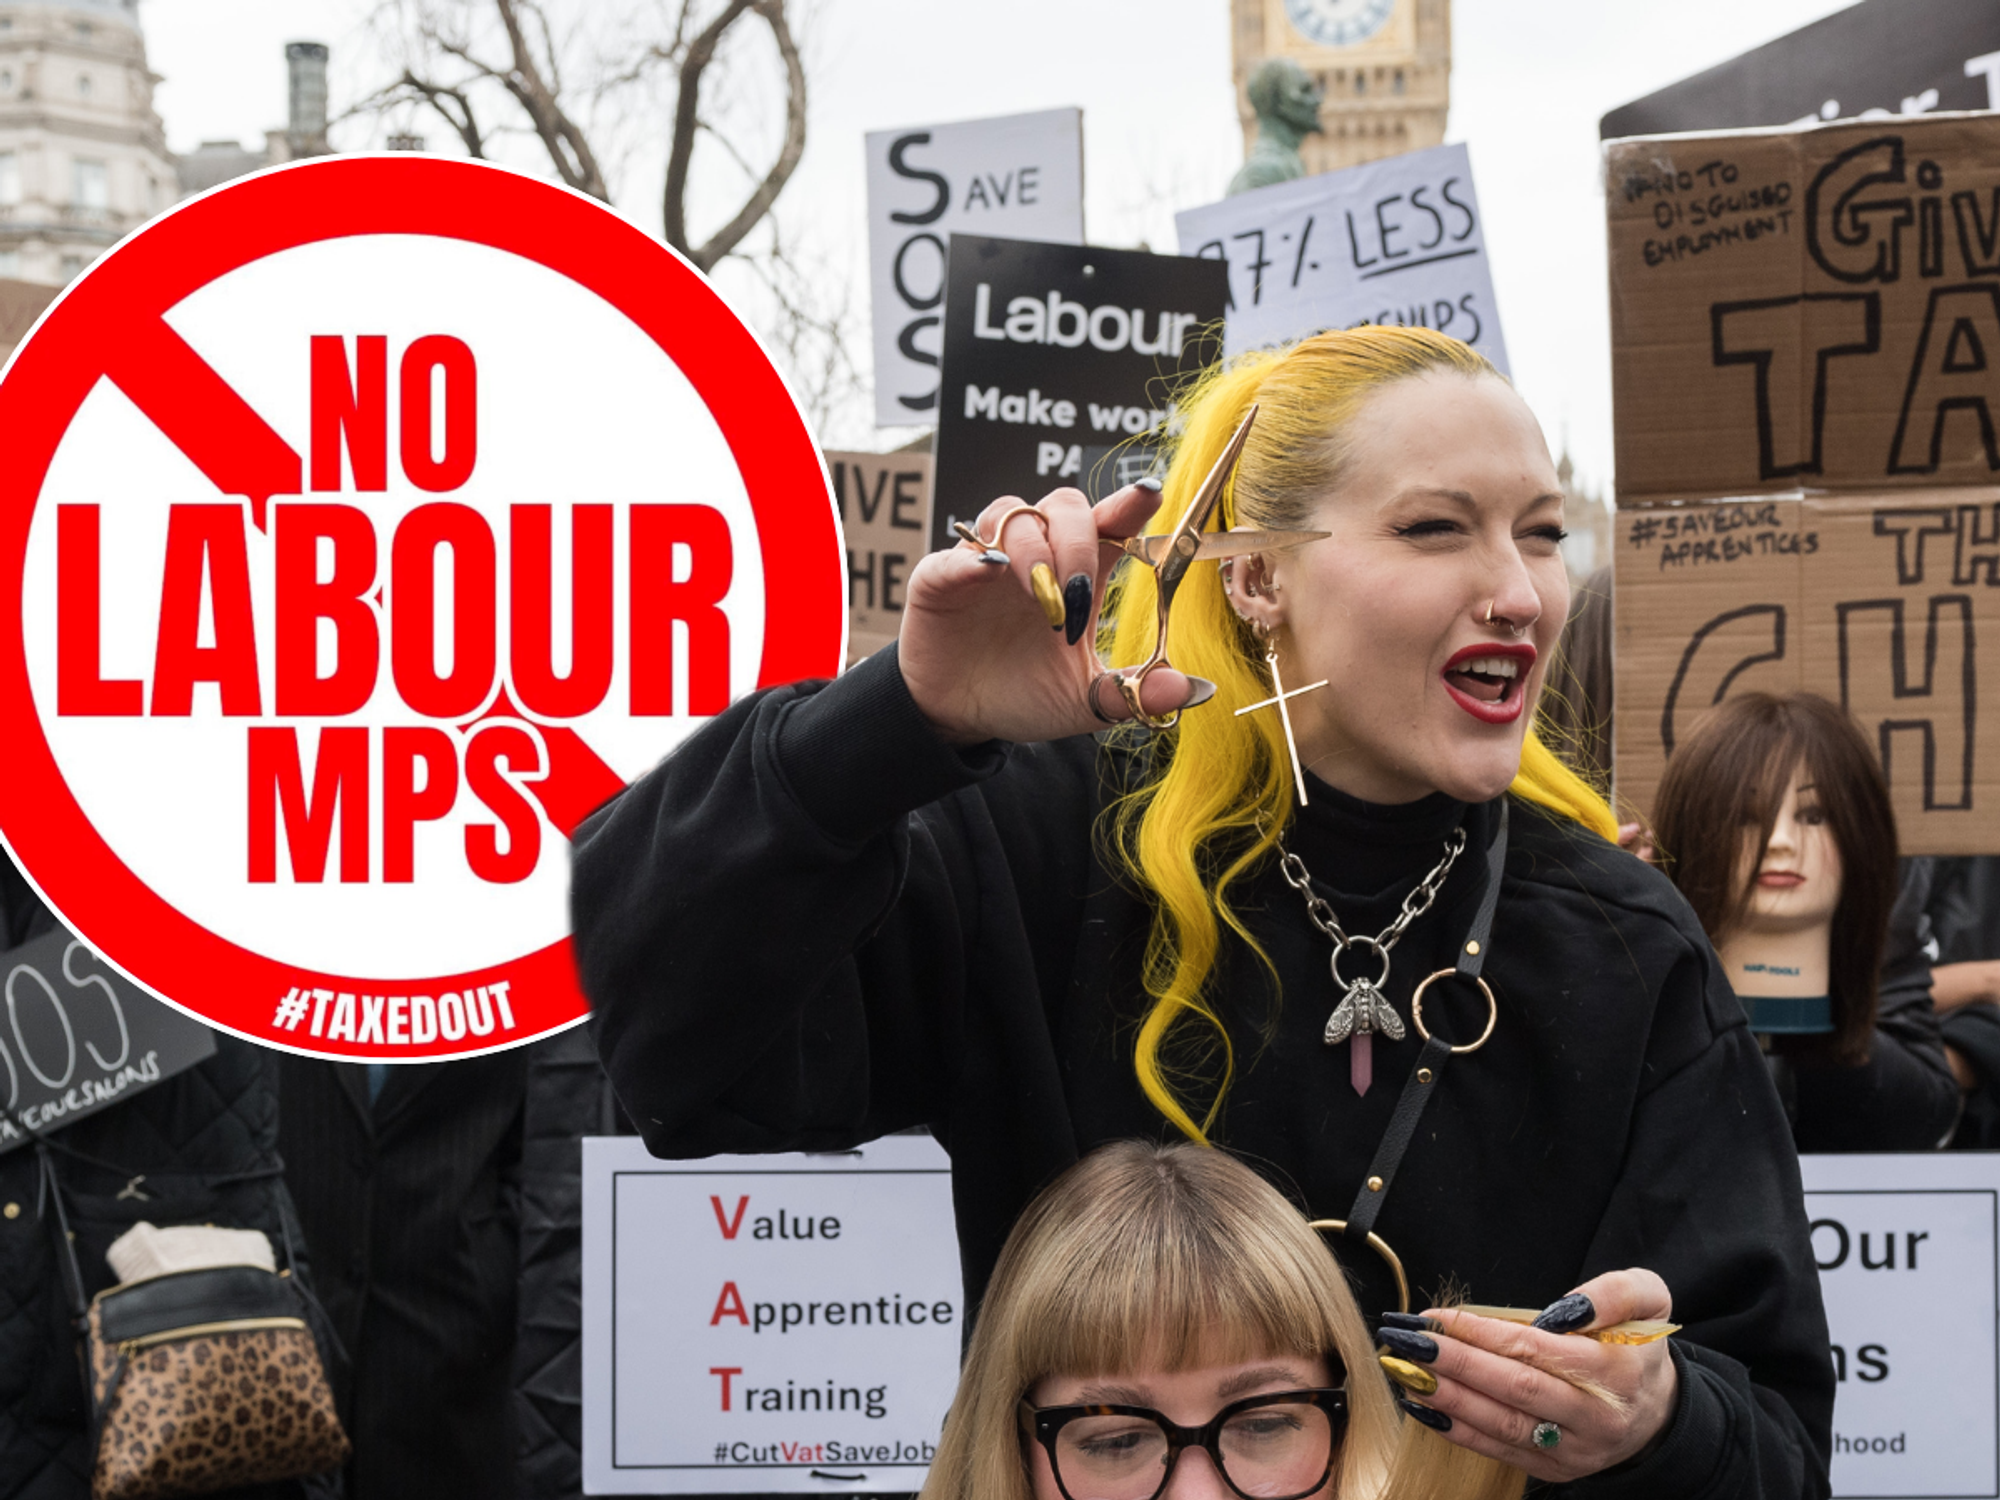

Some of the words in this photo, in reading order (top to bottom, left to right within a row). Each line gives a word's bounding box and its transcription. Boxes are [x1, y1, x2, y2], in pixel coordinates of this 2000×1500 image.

[1697, 160, 1739, 187] TO
[1346, 177, 1474, 268] LESS
[973, 283, 1197, 356] Labour
[965, 384, 1077, 428] Make
[1629, 504, 1782, 550] #SAVEOUR
[1660, 531, 1820, 572] APPRENTICES
[710, 1195, 842, 1240] Value
[1809, 1218, 1930, 1271] Our
[709, 1281, 954, 1334] Apprentice
[709, 1367, 888, 1418] Training
[714, 1441, 936, 1463] #CutVatSaveJob
